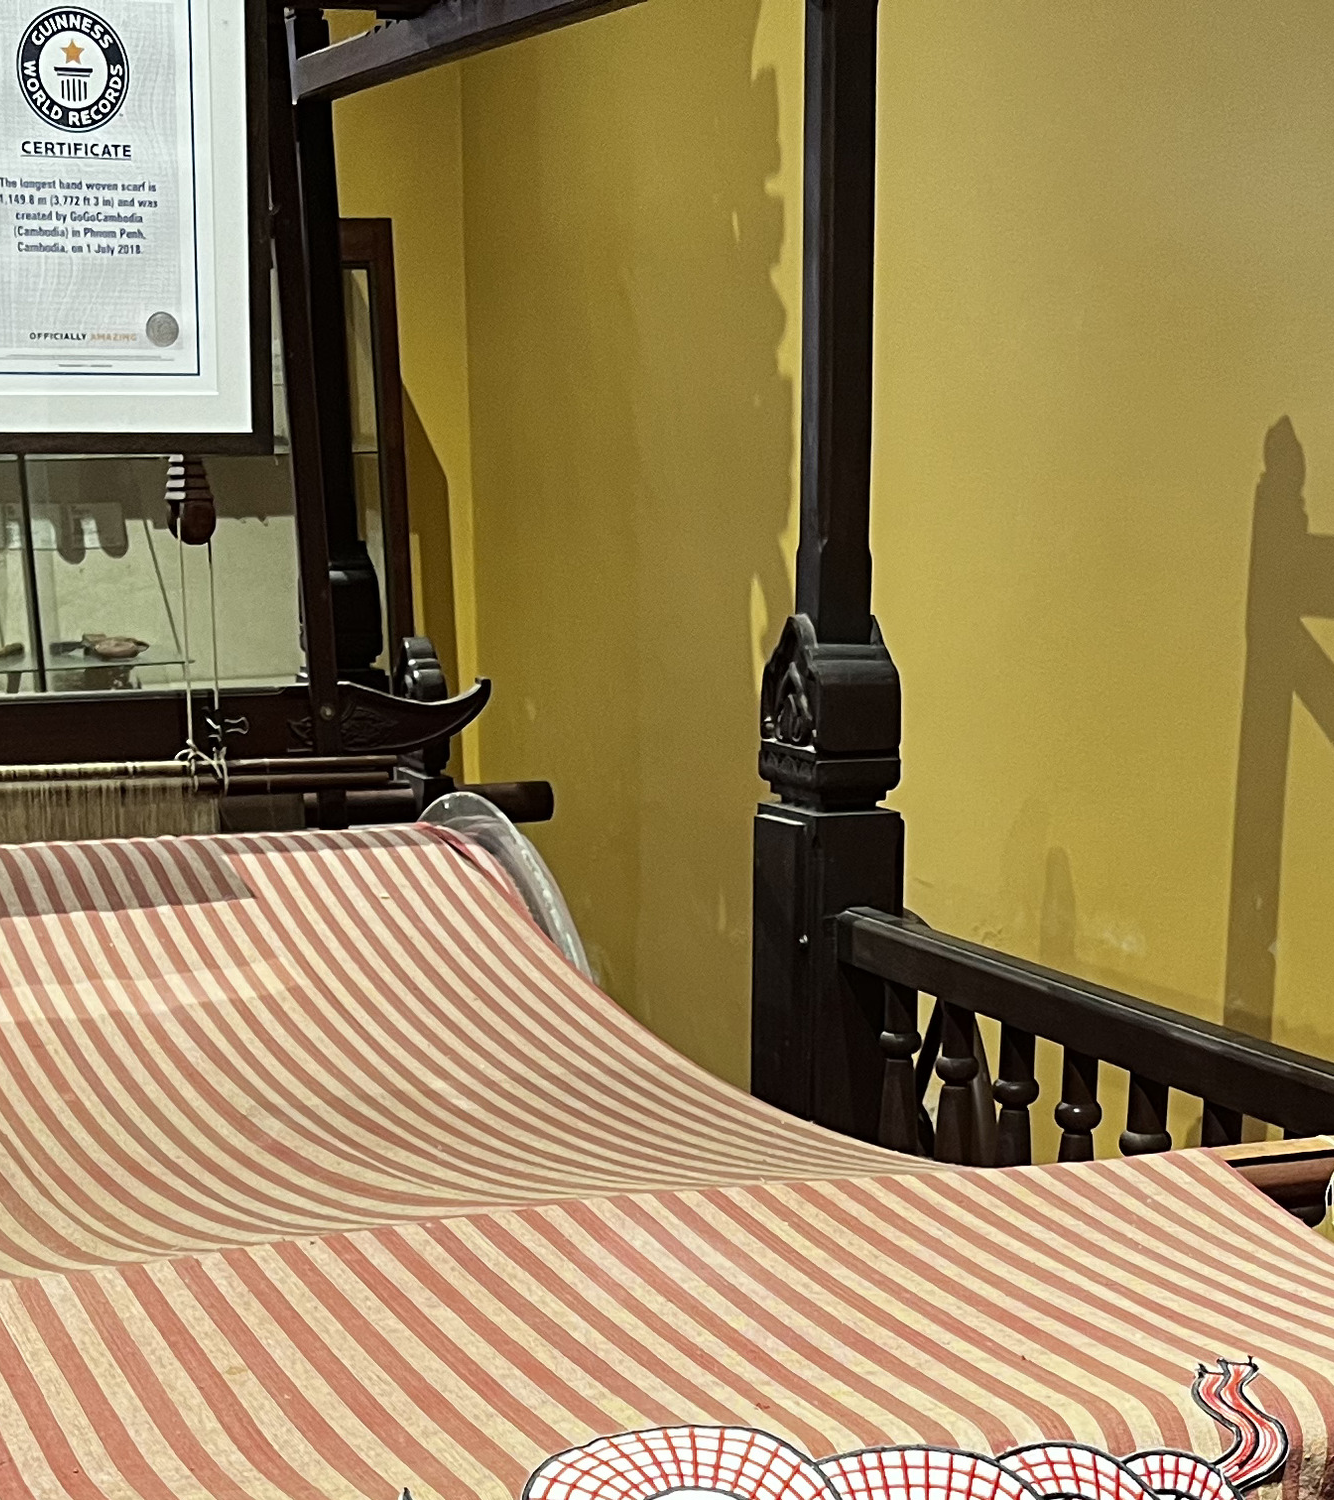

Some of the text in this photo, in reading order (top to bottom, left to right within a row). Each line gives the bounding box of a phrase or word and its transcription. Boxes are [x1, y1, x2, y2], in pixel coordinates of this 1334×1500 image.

[31, 14, 114, 49] GUINNESS
[23, 60, 123, 126] WORLD RECORDS
[21, 141, 132, 157] CERTIFICATE
[0, 177, 156, 192] The longest hand woven scarf is
[38, 196, 47, 205] m
[50, 195, 80, 207] (3,772
[83, 196, 90, 206] ft
[94, 196, 99, 206] 3
[102, 196, 114, 208] in)
[118, 197, 134, 207] and
[138, 199, 158, 208] was
[16, 211, 143, 224] created by GoGoCambodia
[14, 226, 146, 239] (Cambodia) in Phnom Penh,
[17, 242, 67, 254] Cambodia,
[71, 245, 83, 253] on
[87, 244, 91, 253] 1
[95, 244, 115, 256] July
[29, 332, 137, 341] OFFICIALLY AMAZING
